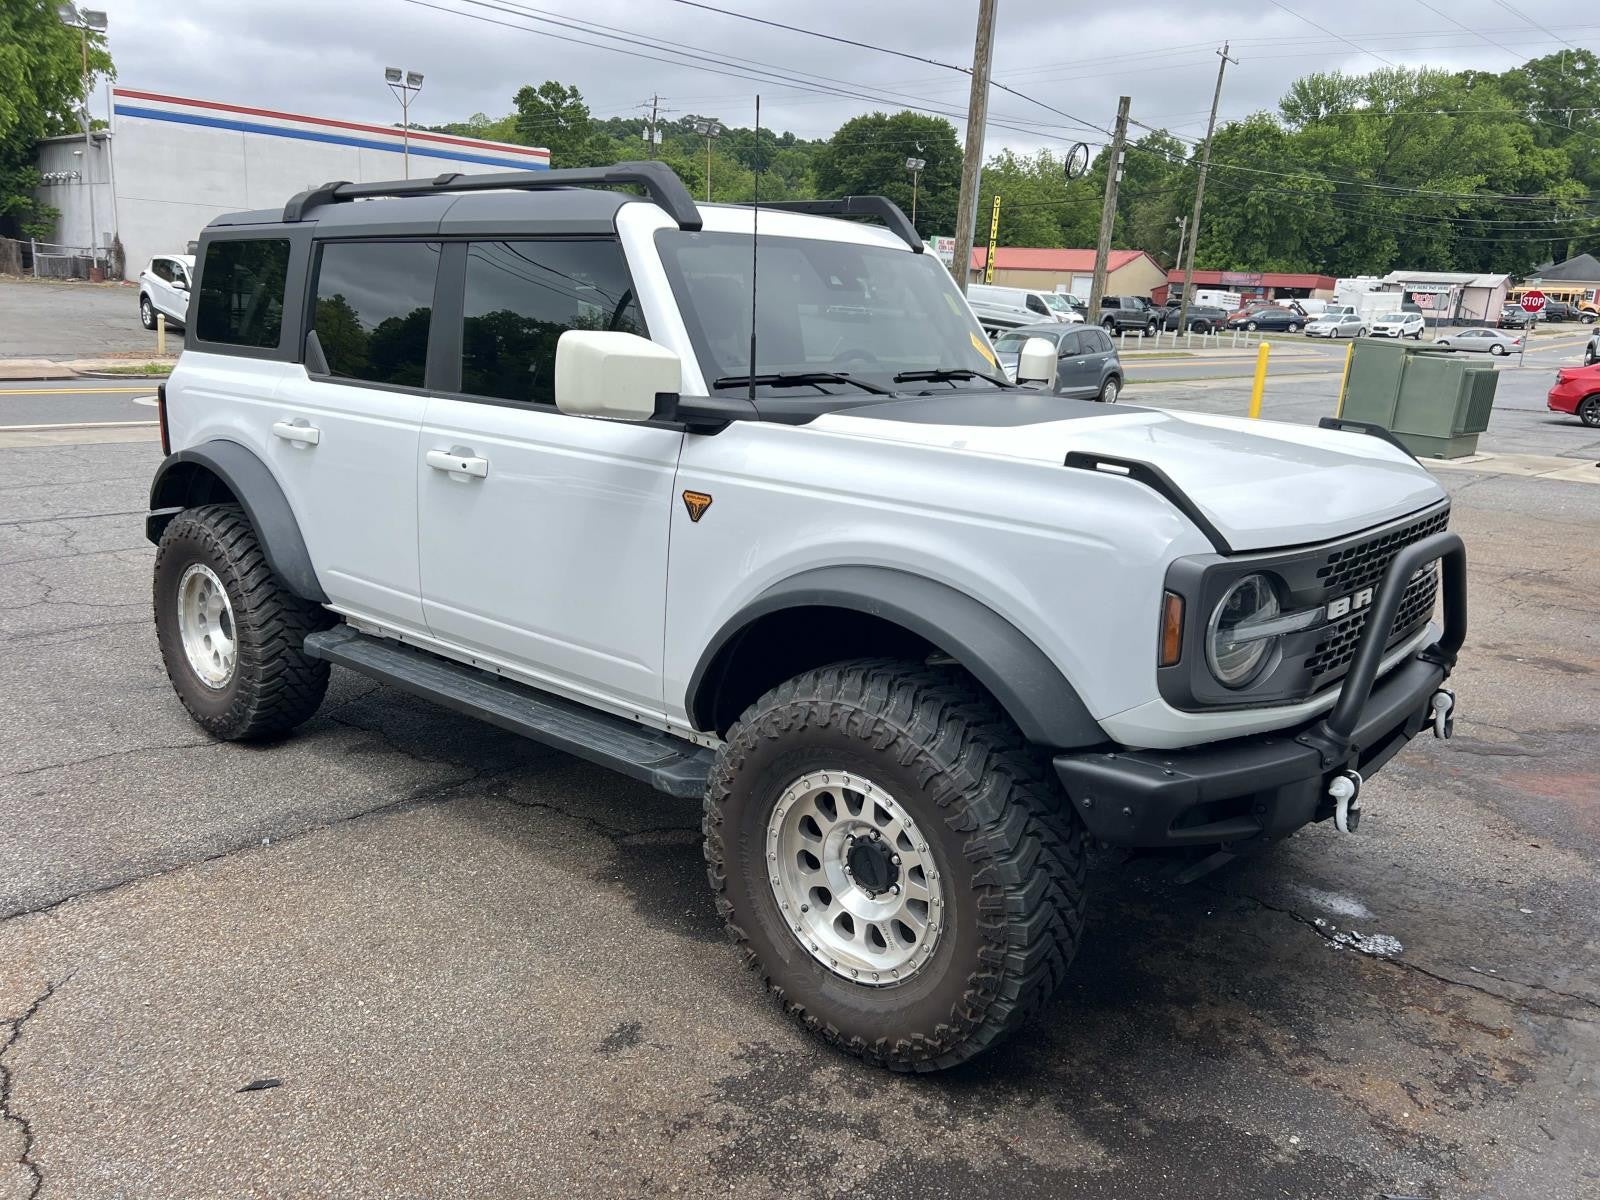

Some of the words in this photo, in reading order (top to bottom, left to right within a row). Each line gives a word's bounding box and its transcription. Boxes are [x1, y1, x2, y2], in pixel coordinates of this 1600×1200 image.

[992, 197, 1000, 237] CITY
[987, 242, 995, 281] PAWN
[1522, 296, 1545, 307] STOP
